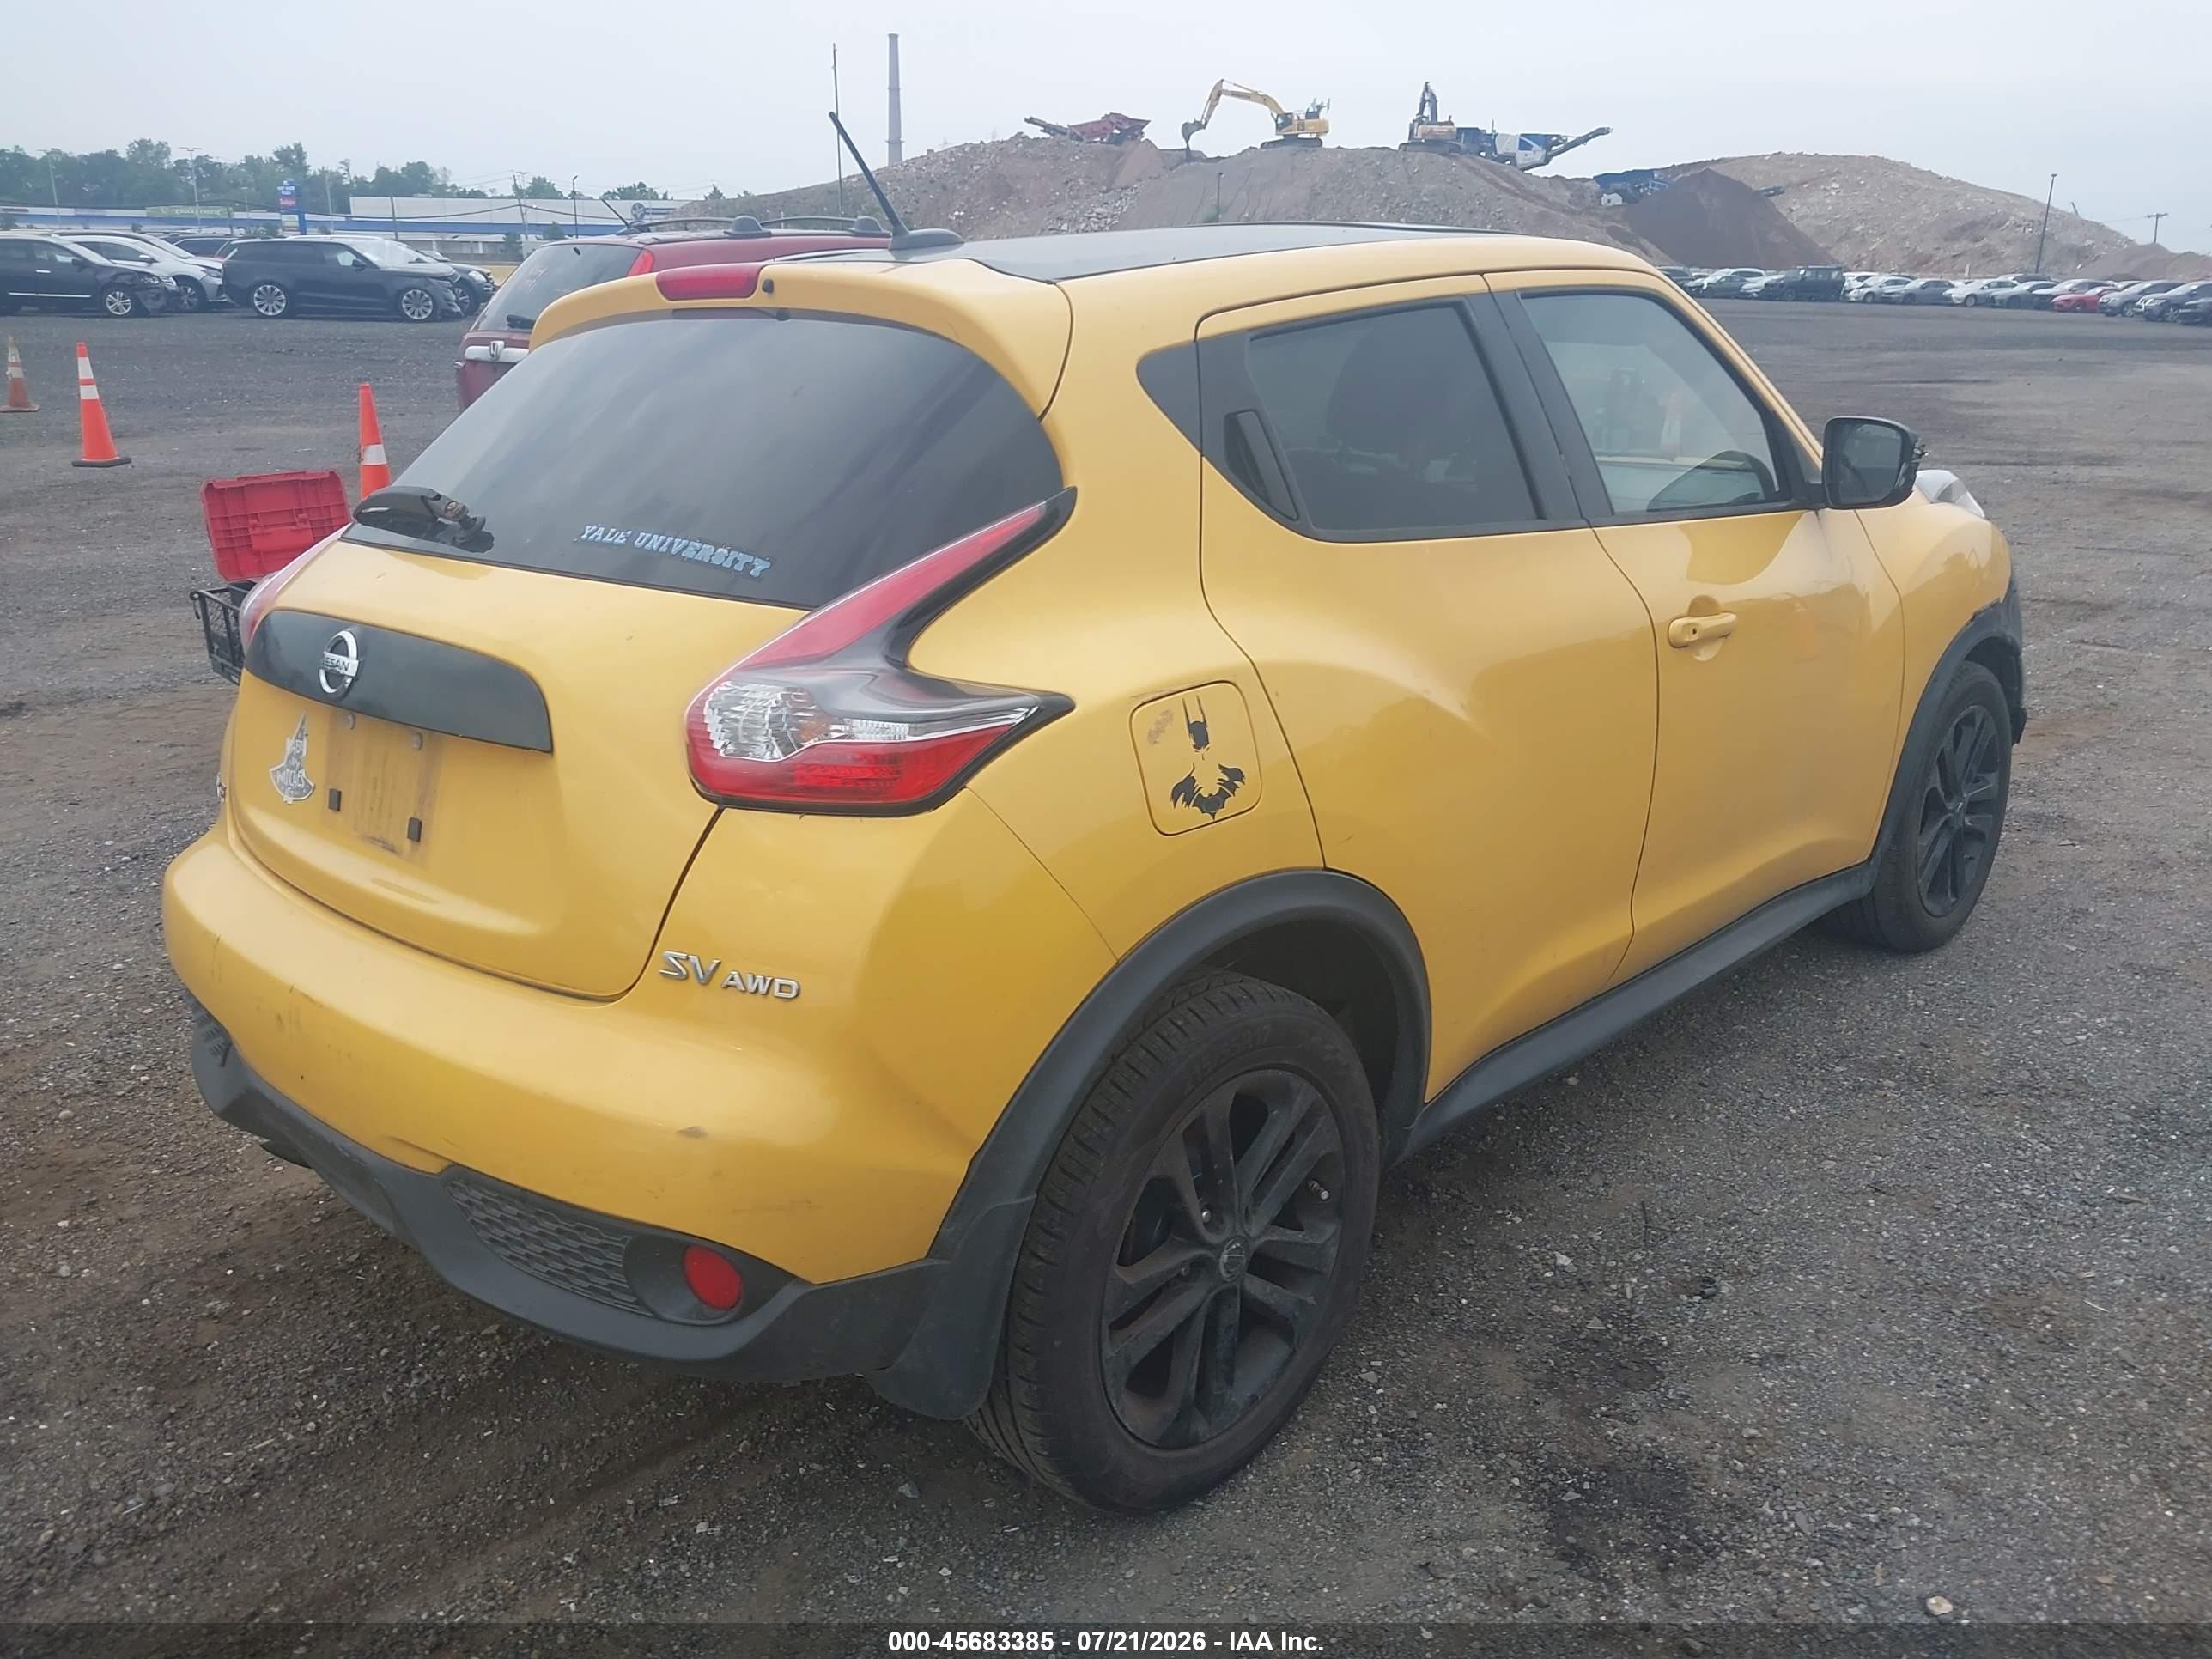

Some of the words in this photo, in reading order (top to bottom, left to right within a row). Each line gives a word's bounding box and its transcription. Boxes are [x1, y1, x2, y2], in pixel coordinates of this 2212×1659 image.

[580, 524, 632, 546] YALE
[634, 532, 771, 578] UNIVERSITY
[323, 656, 351, 672] SSAN
[659, 951, 722, 986] SV
[721, 970, 801, 1000] AWD
